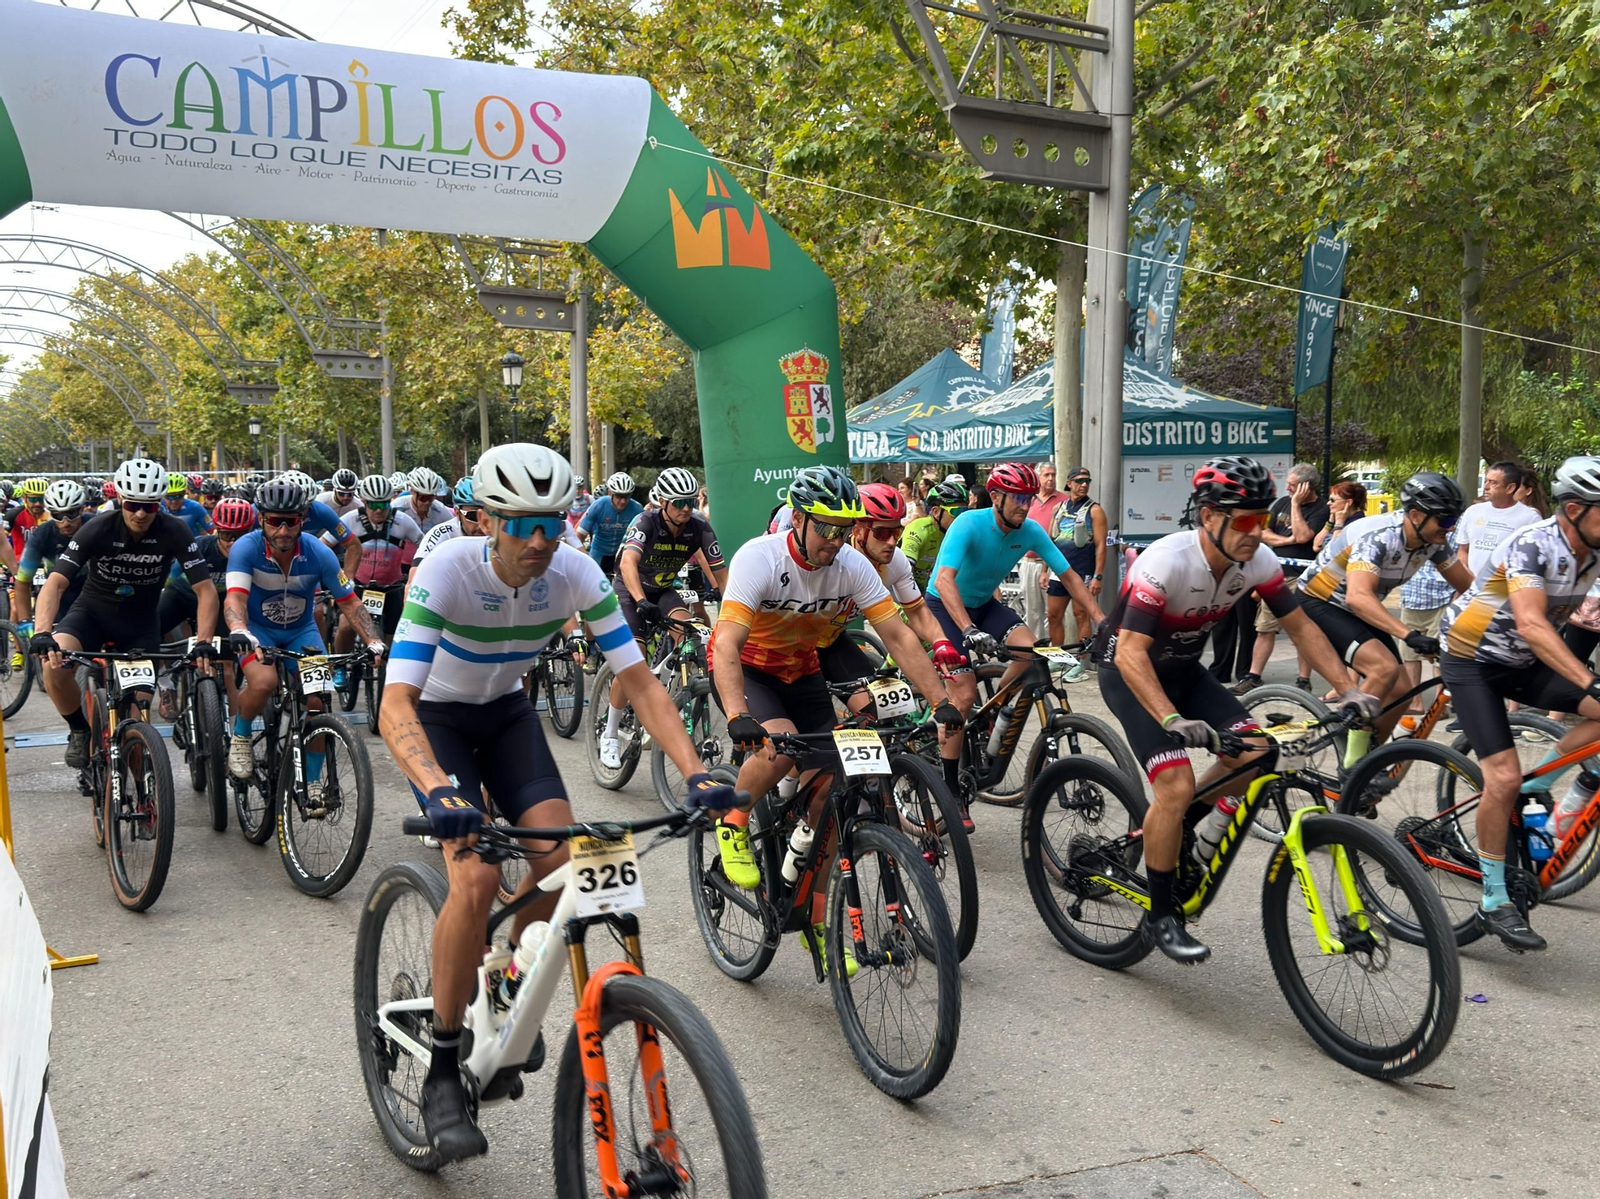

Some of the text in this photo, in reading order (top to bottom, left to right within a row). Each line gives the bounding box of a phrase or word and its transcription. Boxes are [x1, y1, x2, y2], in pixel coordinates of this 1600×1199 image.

[104, 51, 567, 165] CAMPILLOS
[104, 127, 564, 186] TODO LO QUE NECESITAS
[105, 148, 142, 165] Agua
[164, 153, 233, 172] Naturaleza
[254, 162, 282, 176] Aire
[298, 166, 334, 180] Motor
[353, 170, 417, 188] Patrimonio
[436, 178, 476, 193] Deporte
[1316, 235, 1342, 251] PPP
[919, 423, 1033, 453] C.D. DISTRITO 9 BIKE
[1123, 421, 1269, 446] DISTRITO 9 BIKE
[1475, 540, 1499, 548] CYCLIN
[363, 599, 383, 609] 490
[119, 667, 152, 679] 620
[877, 688, 911, 708] 393
[842, 746, 882, 762] 257
[277, 814, 289, 855] MAXXIS
[578, 861, 638, 893] 326
[851, 916, 863, 943] FOX
